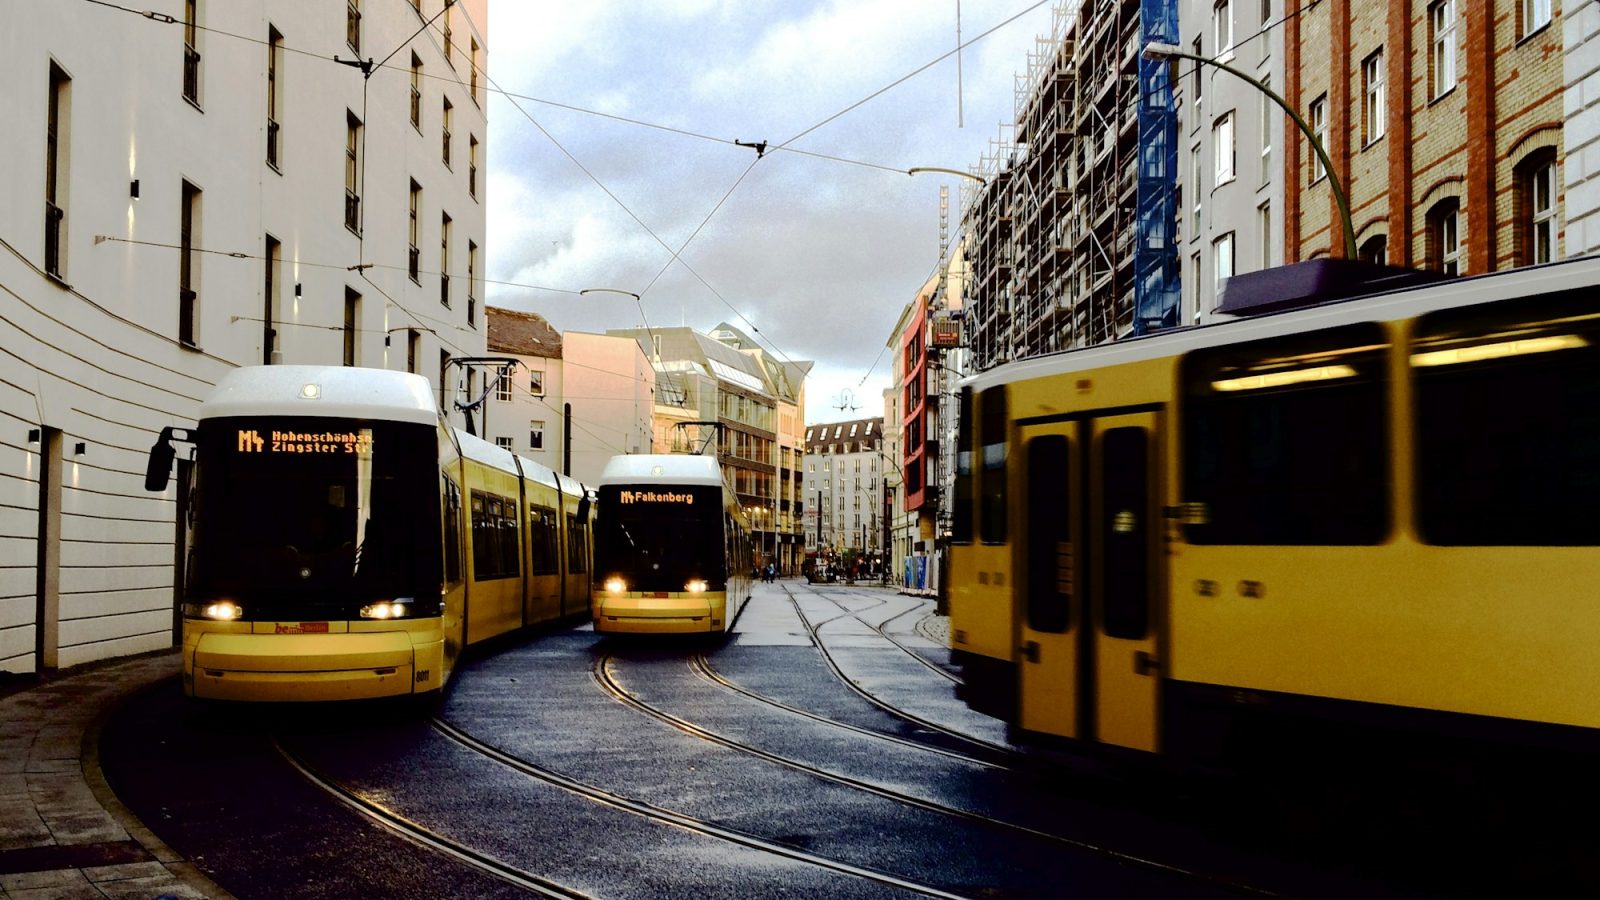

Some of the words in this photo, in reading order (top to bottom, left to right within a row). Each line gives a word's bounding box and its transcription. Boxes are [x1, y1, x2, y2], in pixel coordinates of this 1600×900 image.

[238, 430, 264, 452] M4
[272, 442, 338, 453] Zingster
[620, 491, 634, 504] M4
[635, 491, 693, 504] Falkenberg
